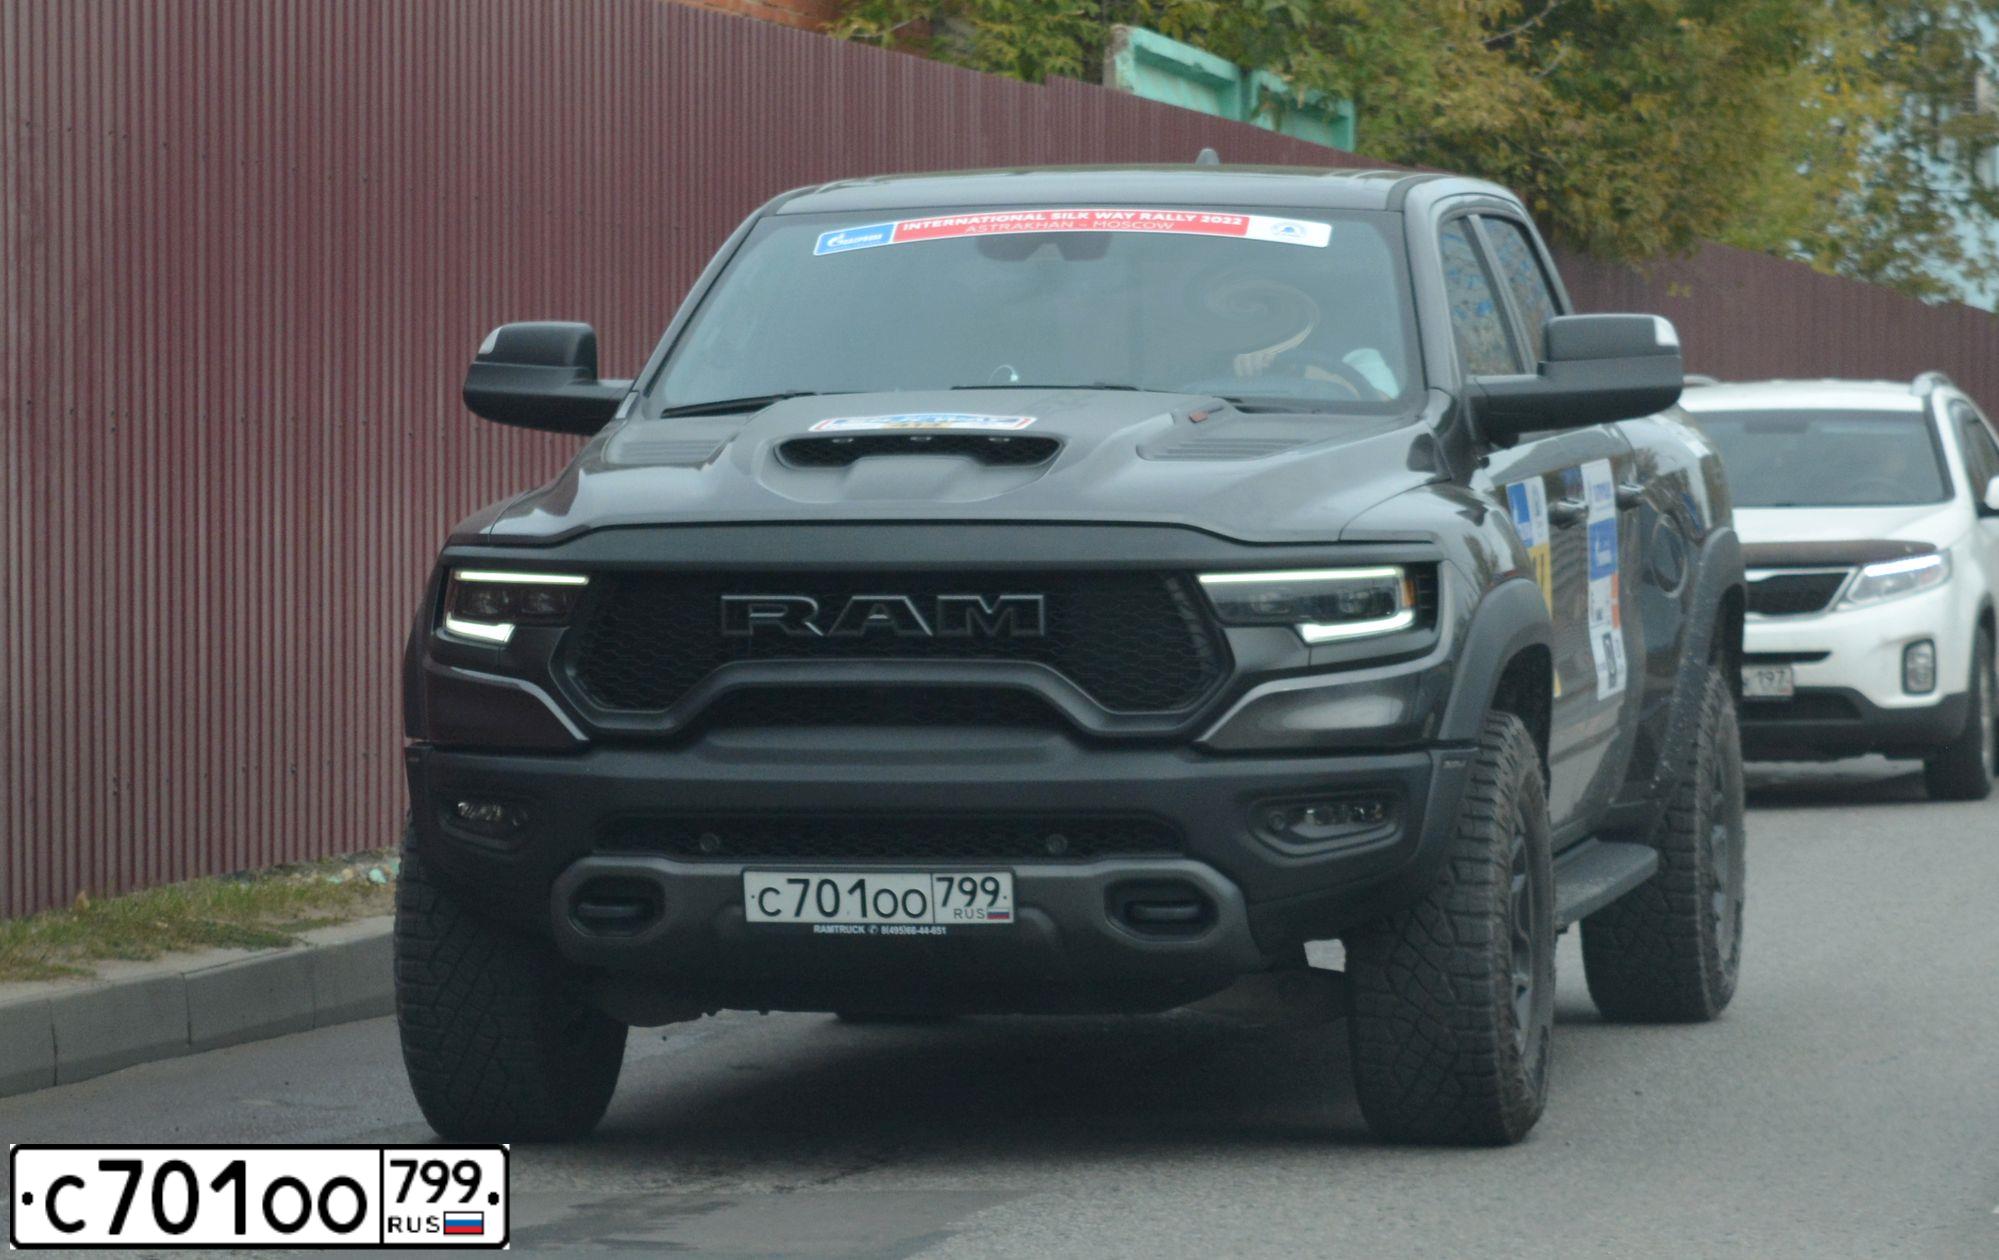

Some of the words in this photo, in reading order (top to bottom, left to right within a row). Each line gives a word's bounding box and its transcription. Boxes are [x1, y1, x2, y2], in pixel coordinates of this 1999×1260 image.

[903, 213, 1046, 231] INTERNATIONAL
[1051, 212, 1089, 221] SILK
[1095, 212, 1137, 221] WAY
[1139, 213, 1198, 222] RALLY
[1200, 215, 1243, 225] 2022
[964, 221, 1074, 234] ASTRAKHAN
[1092, 221, 1176, 230] MOSCOW
[721, 595, 1045, 636] RAM
[936, 876, 1001, 908] 799
[953, 908, 986, 920] RUS
[813, 924, 866, 935] RAMTRUCK
